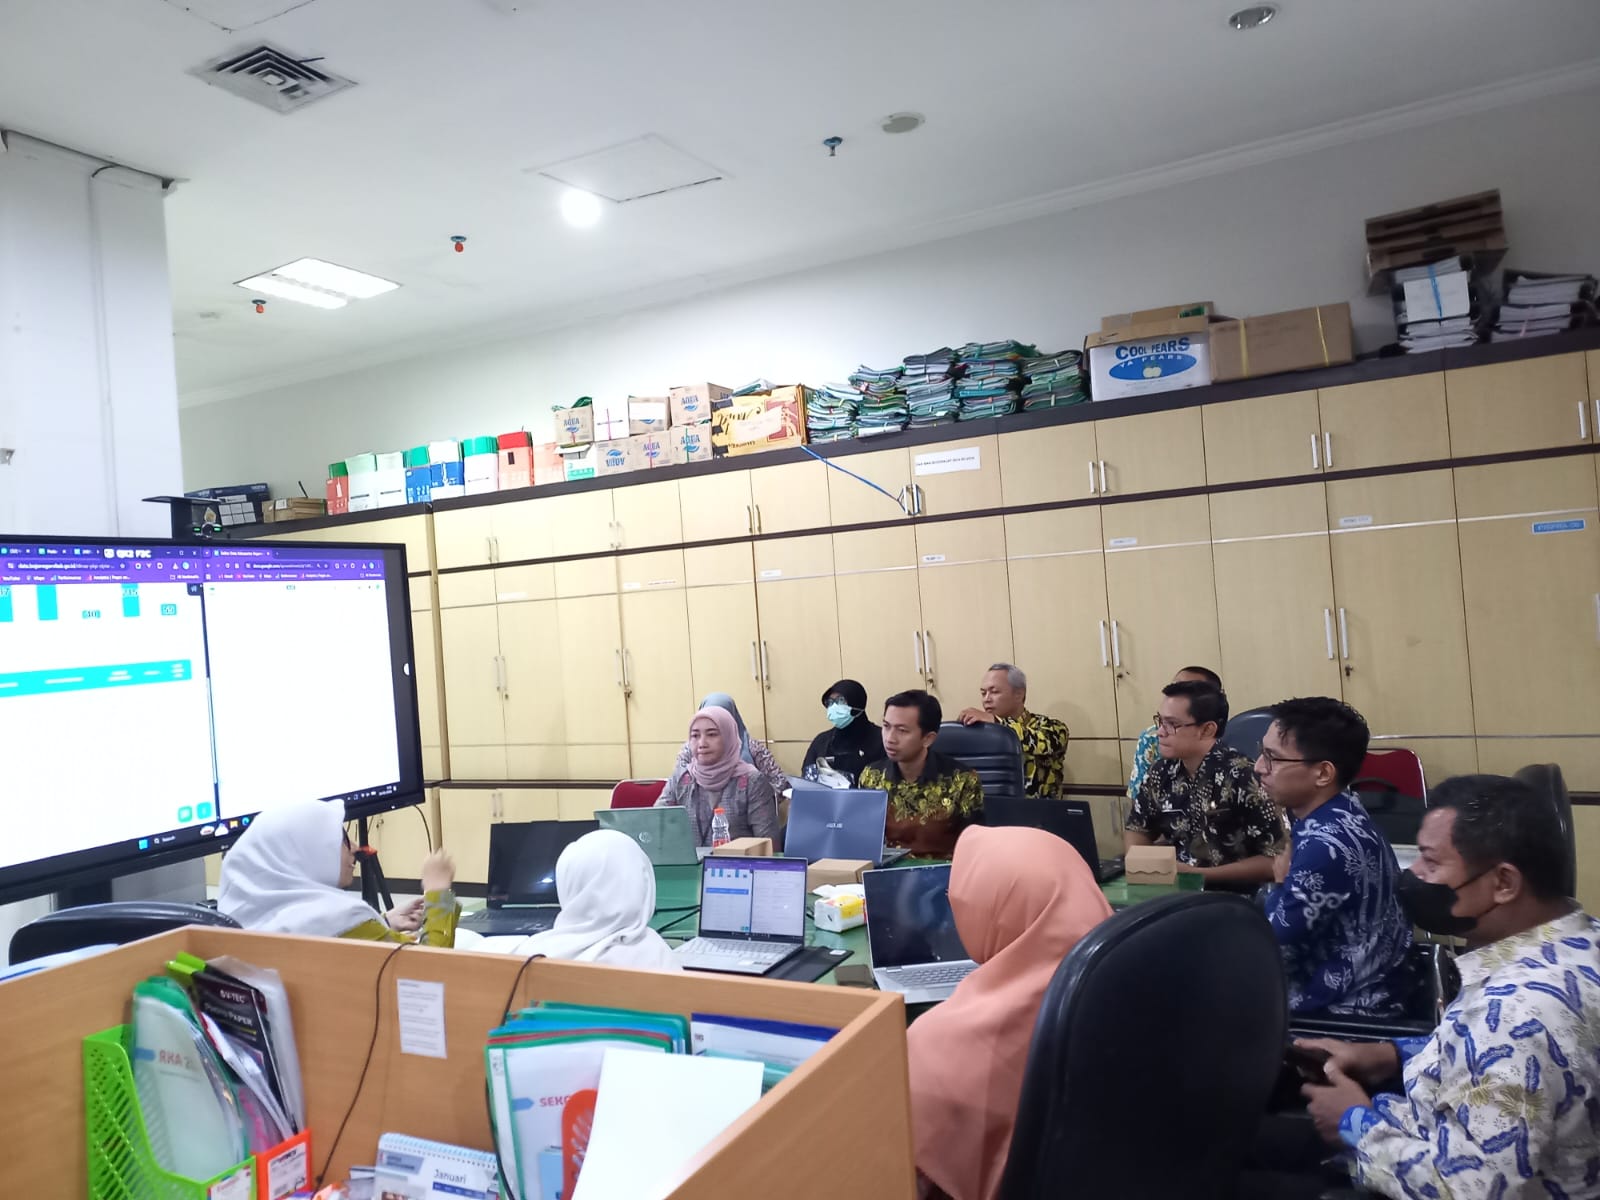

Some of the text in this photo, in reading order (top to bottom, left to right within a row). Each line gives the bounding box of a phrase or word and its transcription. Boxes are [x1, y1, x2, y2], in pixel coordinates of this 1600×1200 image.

[1115, 337, 1190, 360] COOL PEARS
[681, 394, 699, 405] AQUA
[564, 417, 580, 426] AQUA
[680, 434, 701, 444] AQUA
[433, 1168, 466, 1185] Januari
